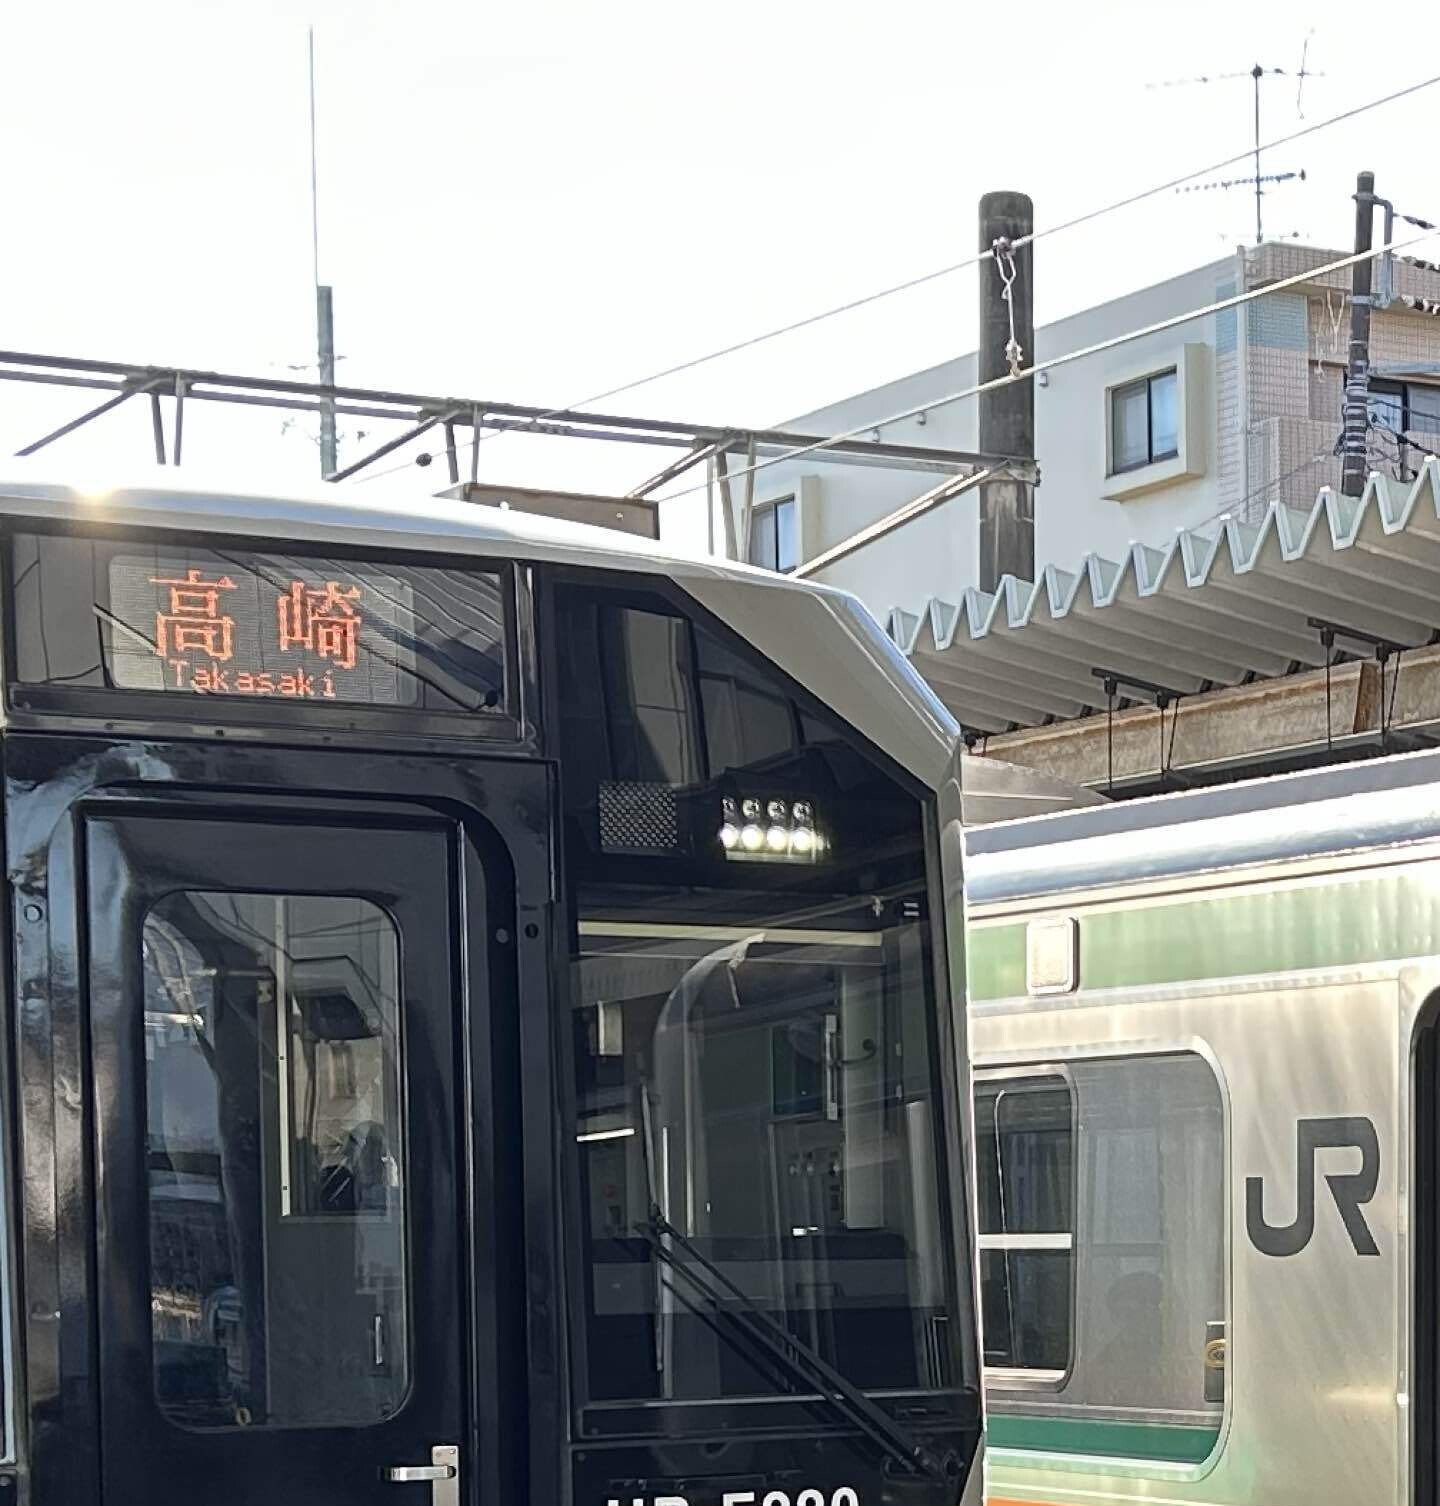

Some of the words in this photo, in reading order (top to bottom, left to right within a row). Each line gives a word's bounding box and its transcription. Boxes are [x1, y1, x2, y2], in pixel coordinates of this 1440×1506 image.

[149, 568, 362, 670] 高崎
[168, 658, 336, 698] Takasaki
[1245, 1116, 1381, 1258] JR
